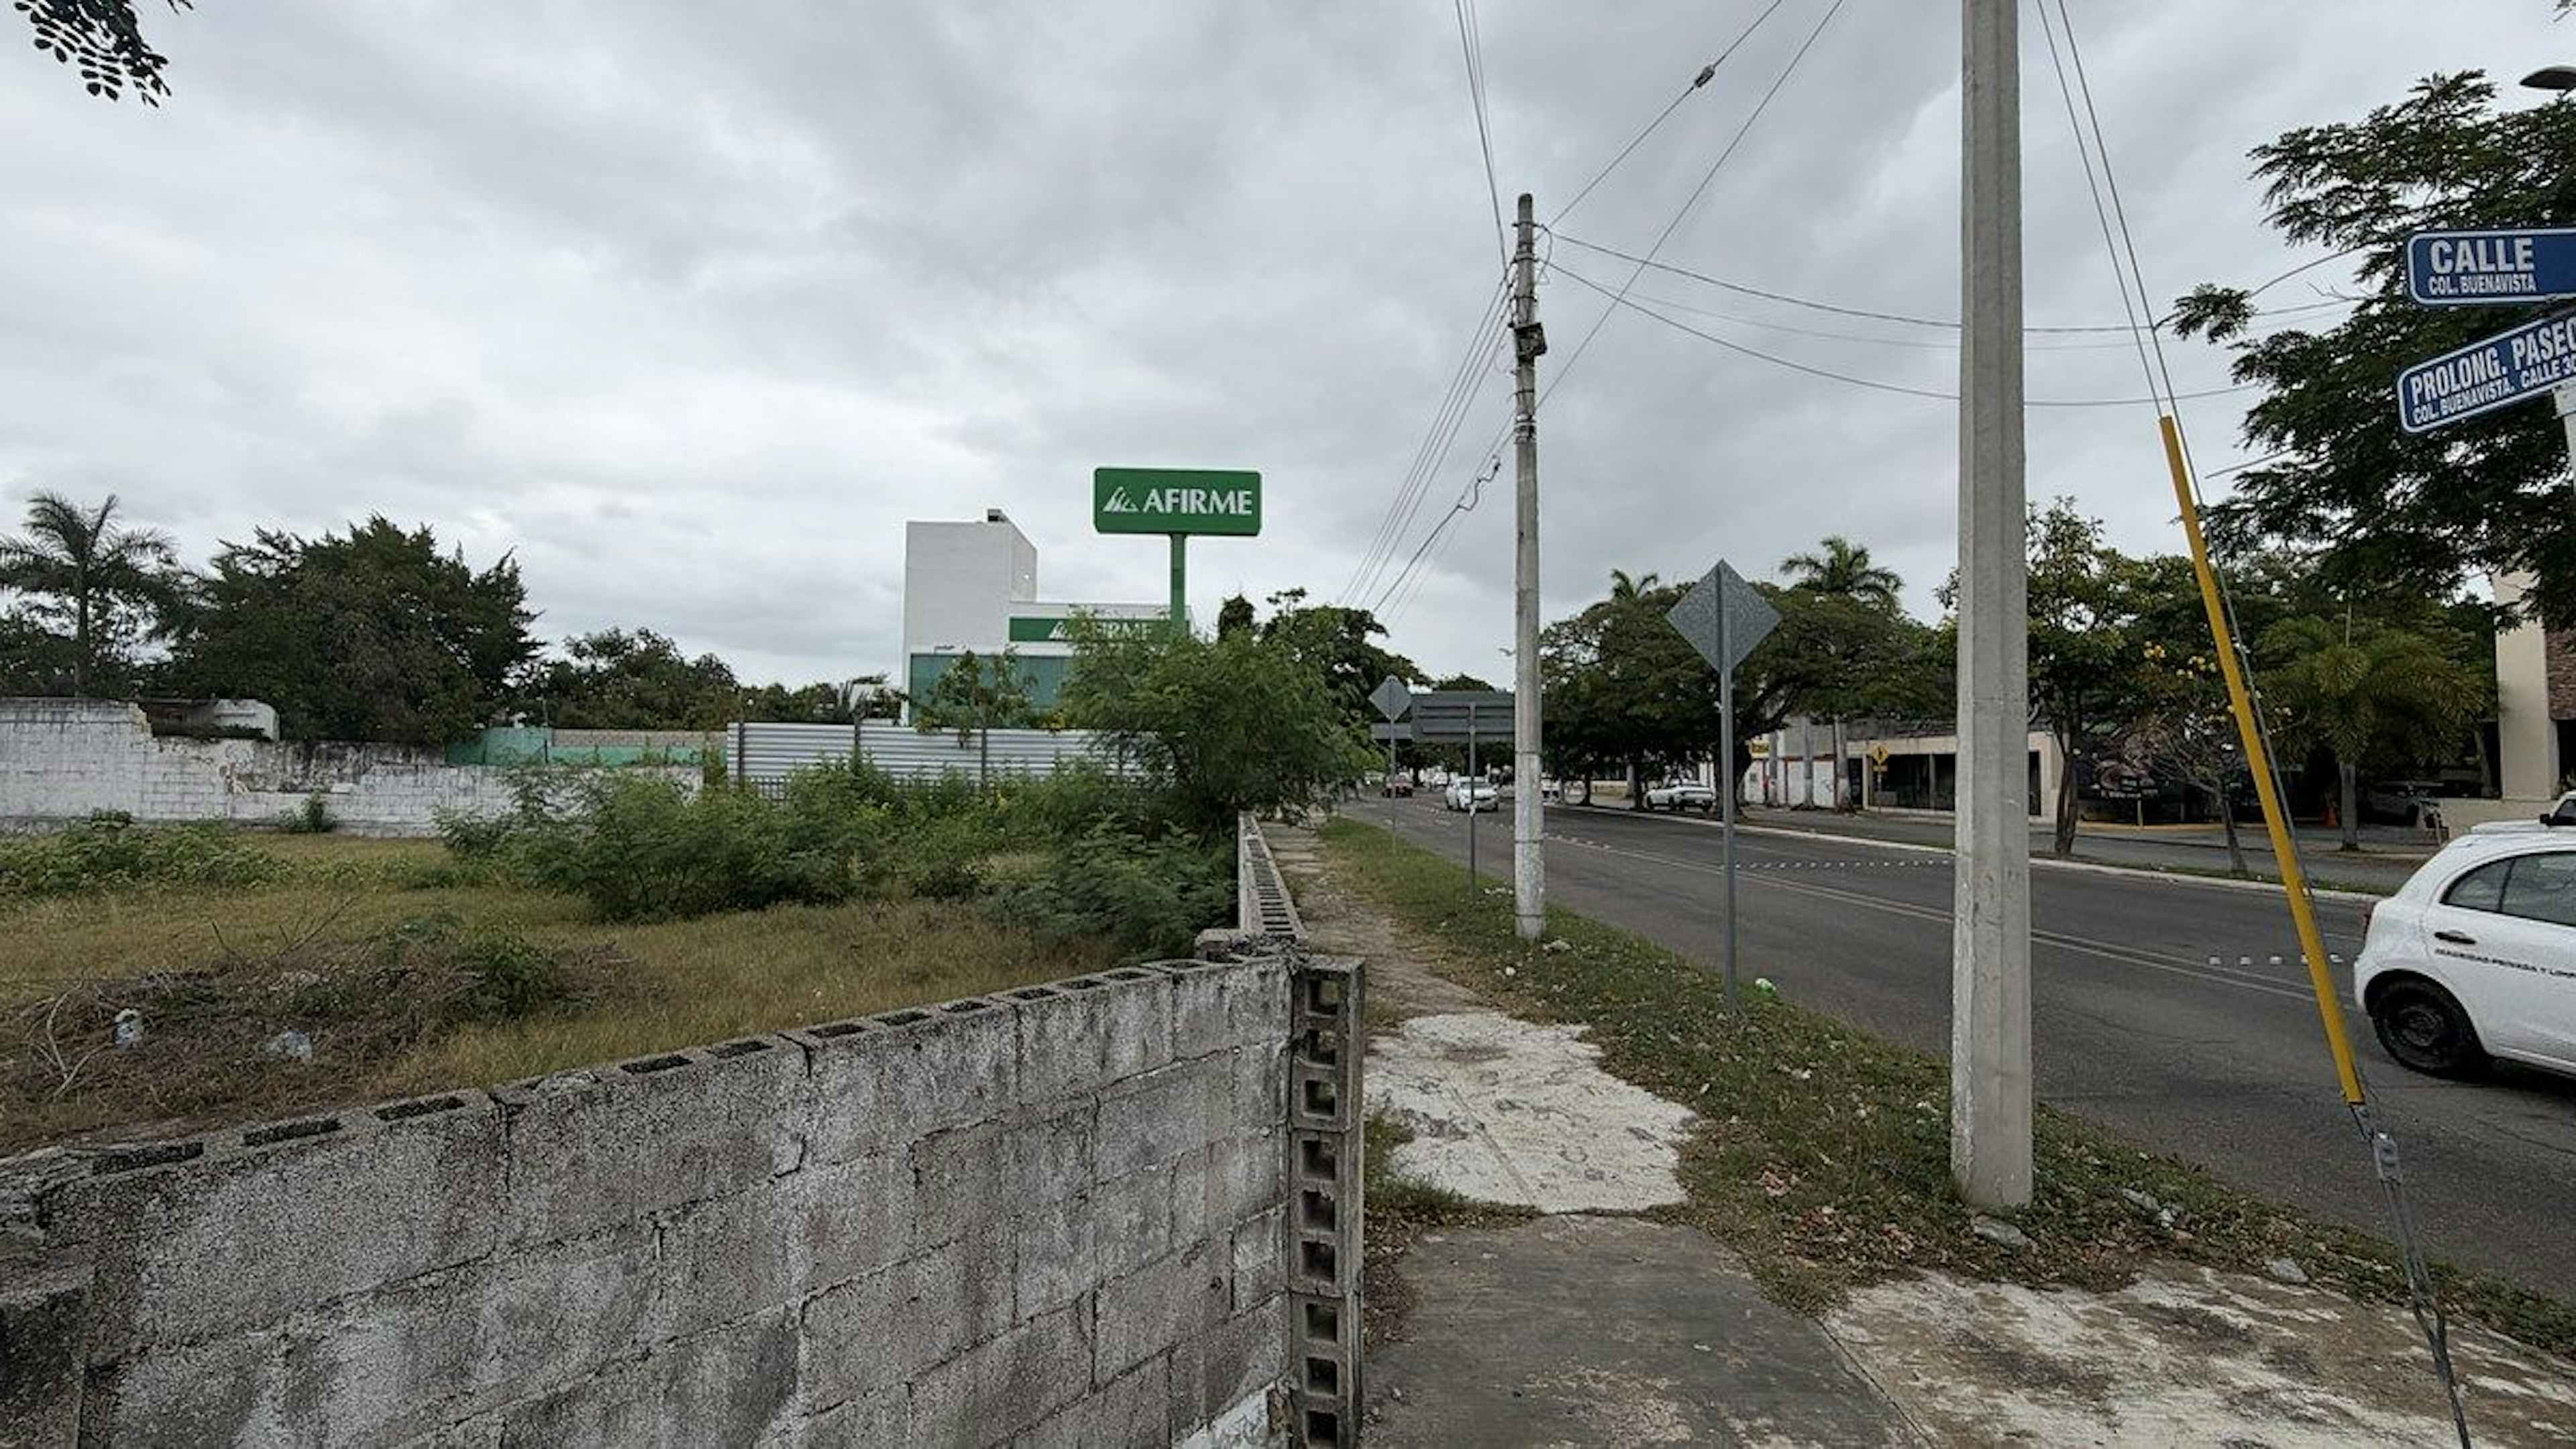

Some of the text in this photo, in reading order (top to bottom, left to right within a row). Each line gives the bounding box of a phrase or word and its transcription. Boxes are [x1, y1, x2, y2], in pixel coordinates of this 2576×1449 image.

[2430, 237, 2535, 274] CALLE
[2428, 272, 2537, 295] COL. BUENAVISTA
[2410, 346, 2508, 405] PROLONG.
[2412, 402, 2440, 425] COL.
[2520, 360, 2563, 389] CALLE
[1142, 488, 1253, 515] AFIRME
